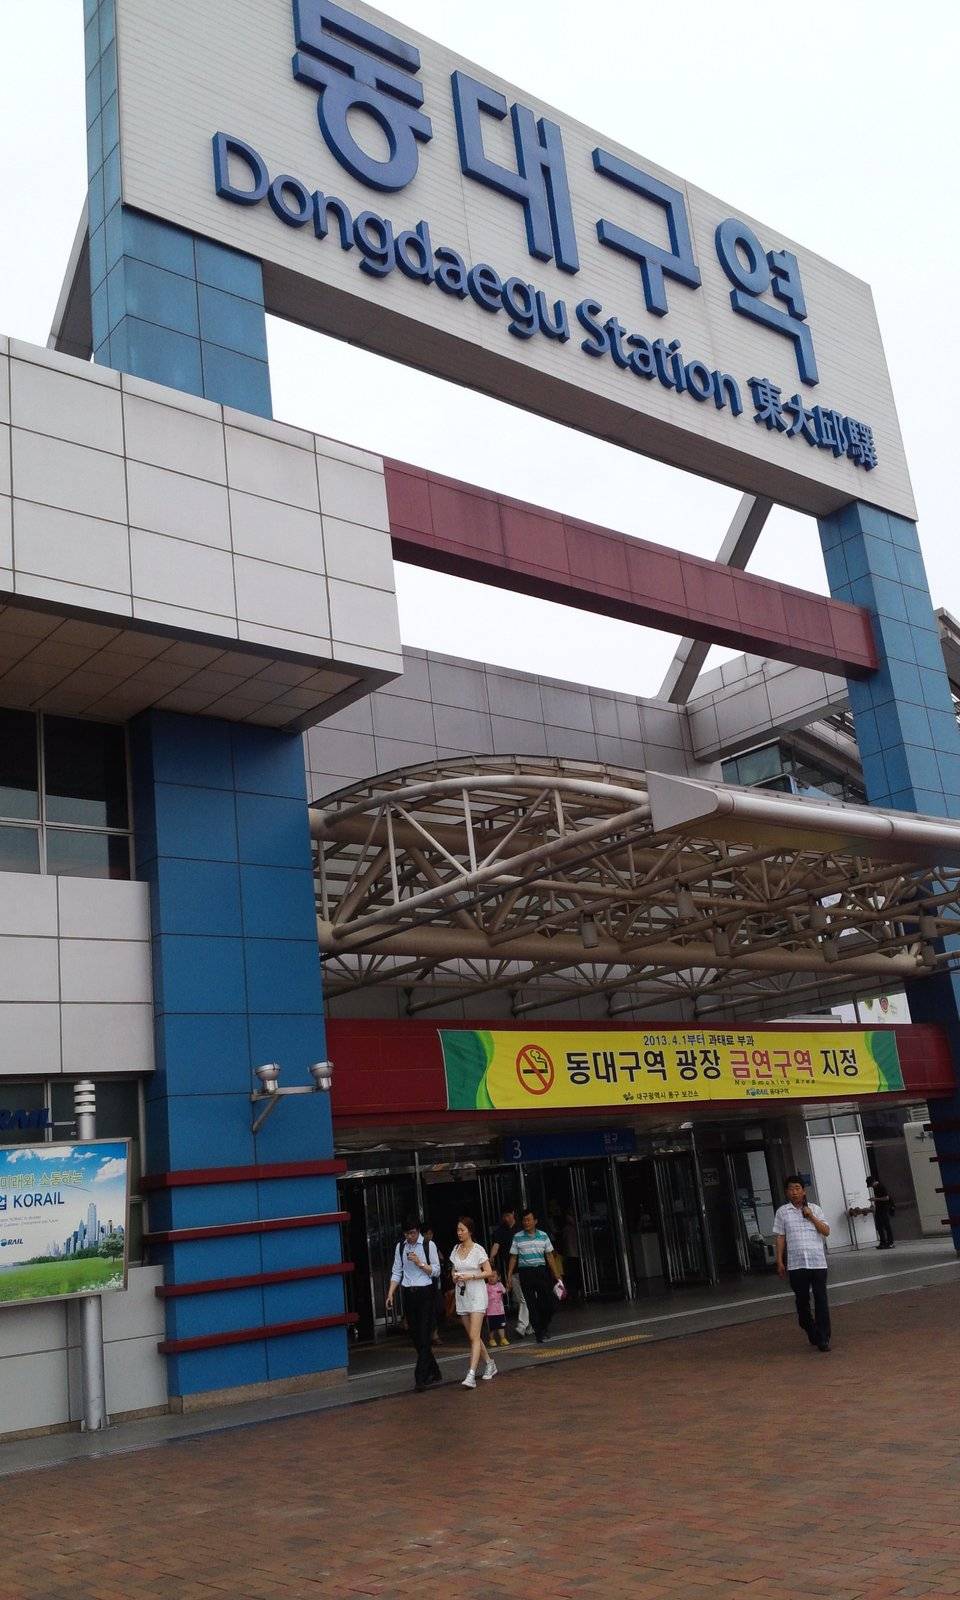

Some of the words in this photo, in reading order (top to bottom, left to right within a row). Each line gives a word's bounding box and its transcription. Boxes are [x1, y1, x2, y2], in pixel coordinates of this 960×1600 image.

[292, 0, 819, 387] 동대구역
[212, 130, 570, 344] Dongdaegu
[576, 298, 744, 417] Station
[709, 1034, 735, 1047] 과태료
[737, 1034, 755, 1047] 부과
[567, 1050, 668, 1084] 동대구역
[676, 1049, 722, 1081] 광장
[729, 1049, 814, 1079] 금연구역
[819, 1048, 859, 1077] 지정
[512, 1139, 522, 1159] 3
[13, 1191, 65, 1209] KORAIL
